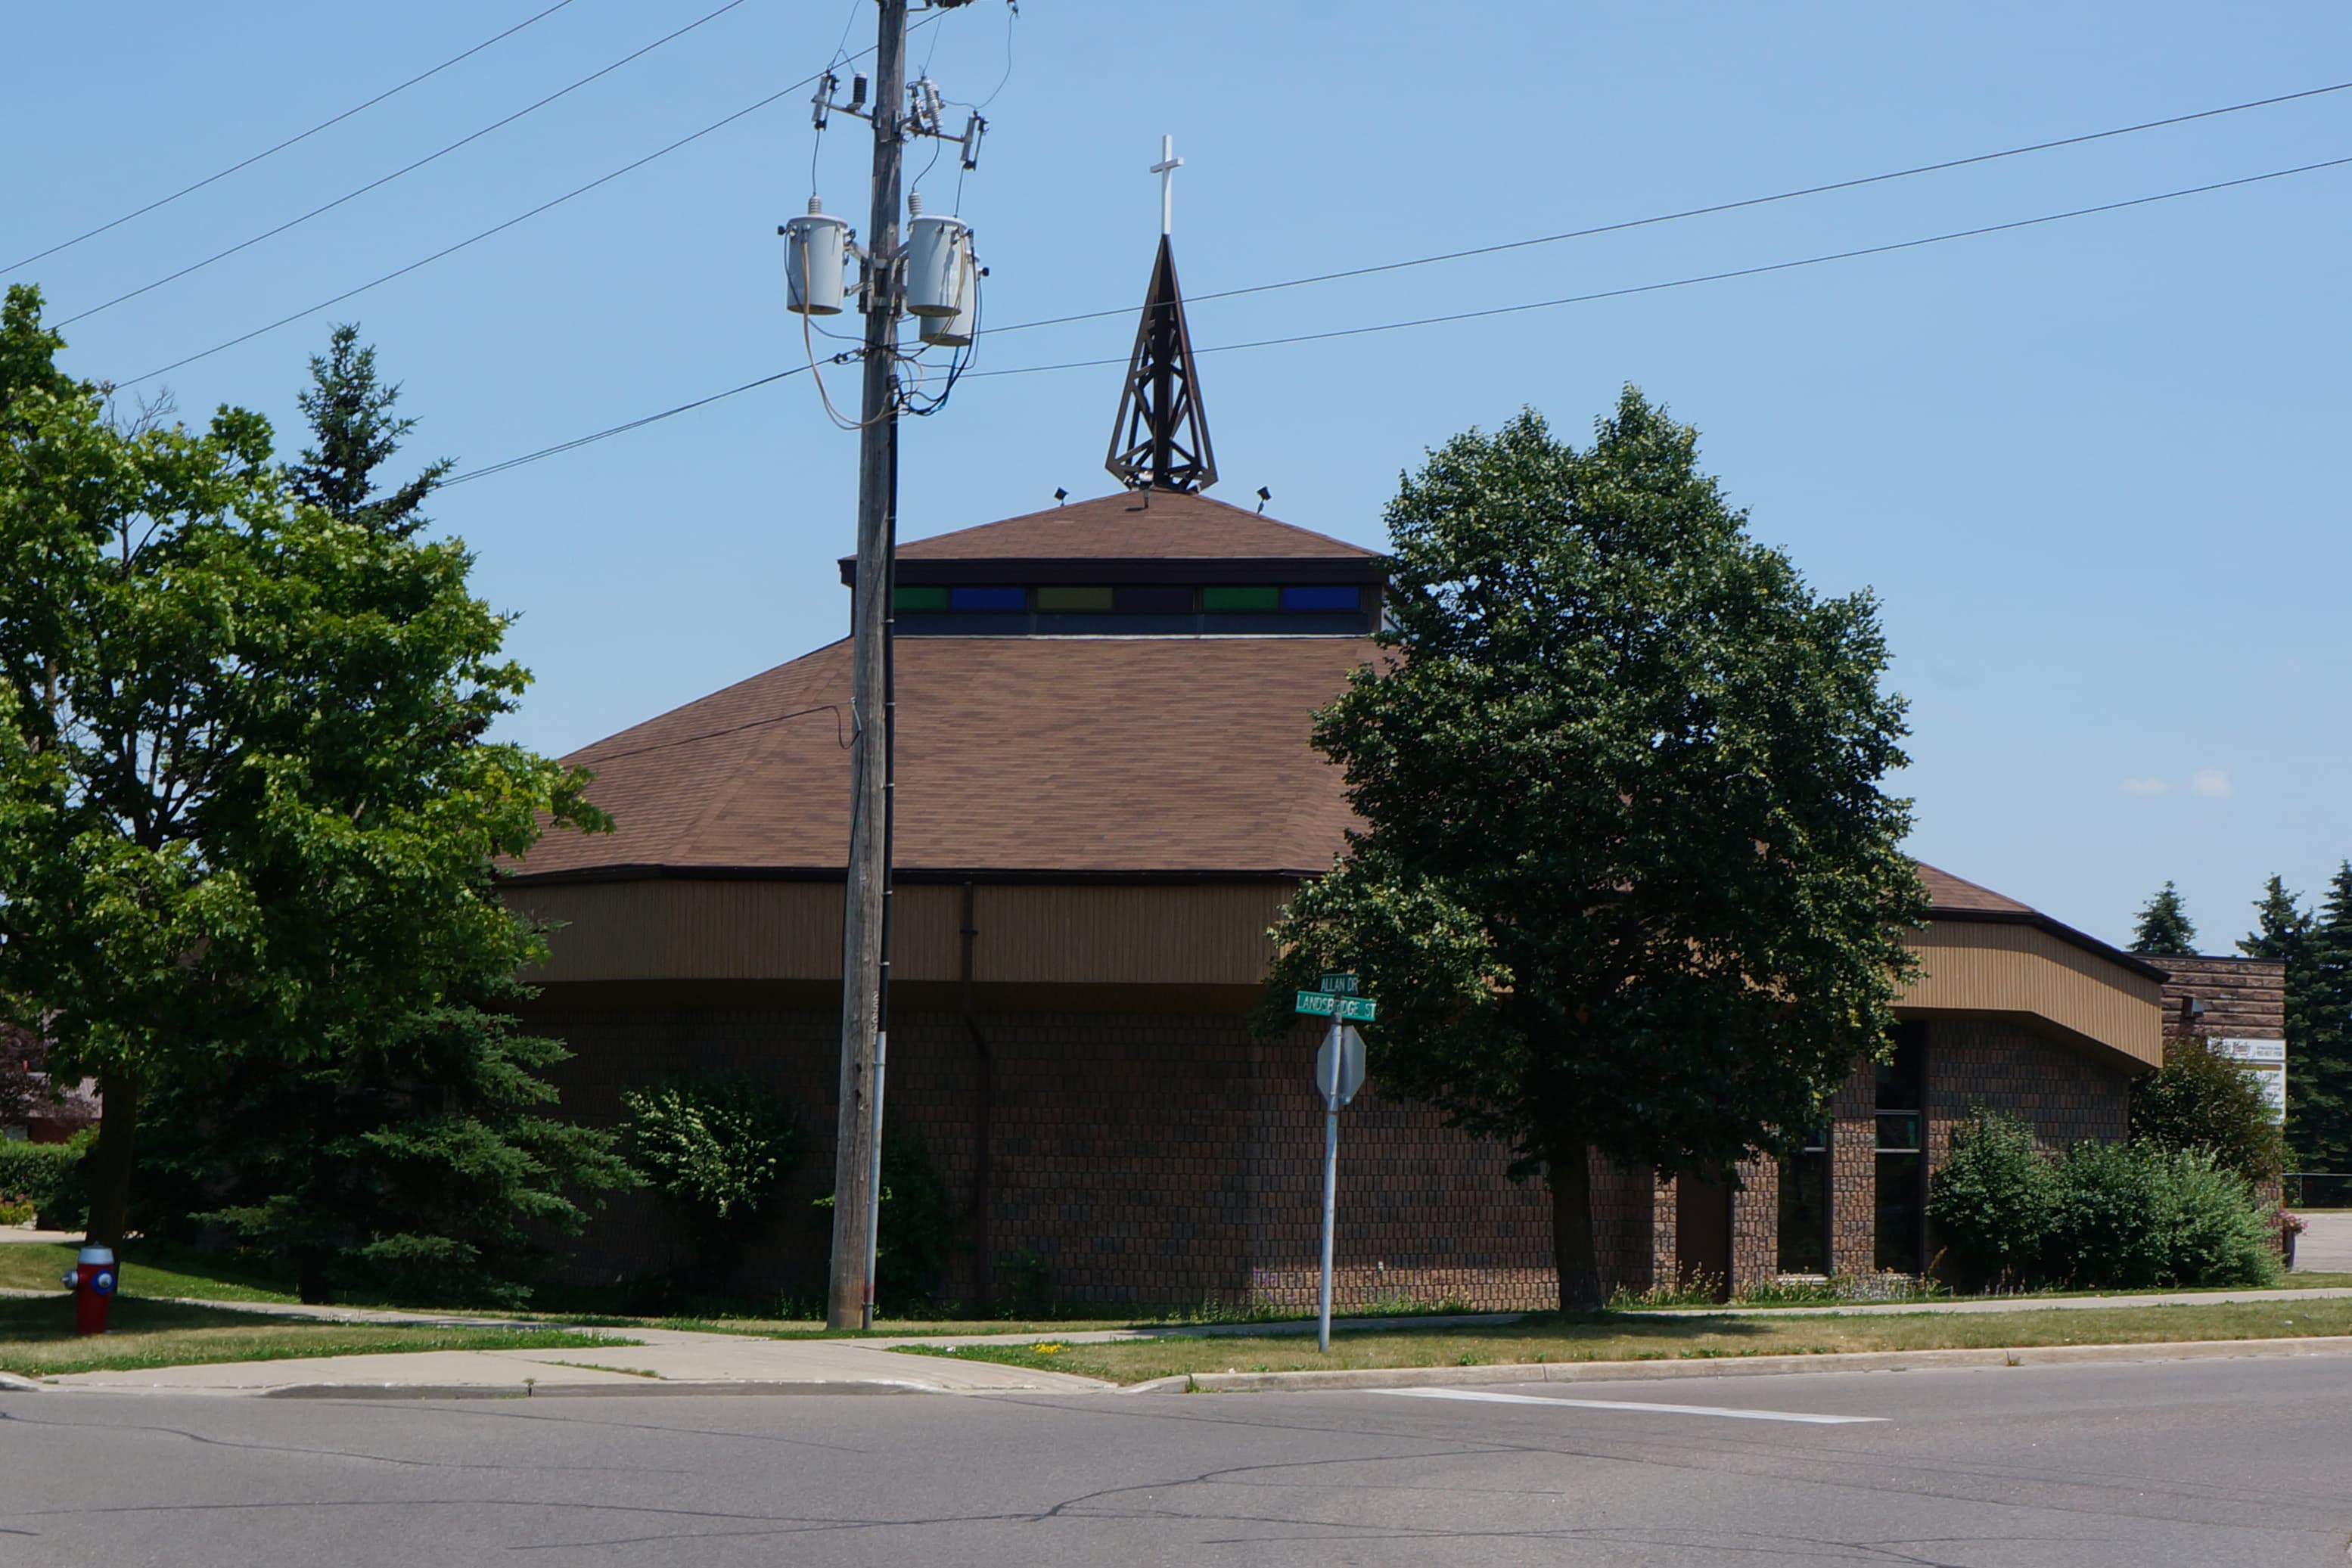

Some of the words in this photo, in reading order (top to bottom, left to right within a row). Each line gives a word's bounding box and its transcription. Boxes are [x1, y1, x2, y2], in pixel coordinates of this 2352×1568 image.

[1320, 977, 1345, 992] ALLAN
[1347, 977, 1359, 992] DR
[1365, 1003, 1377, 1017] ST
